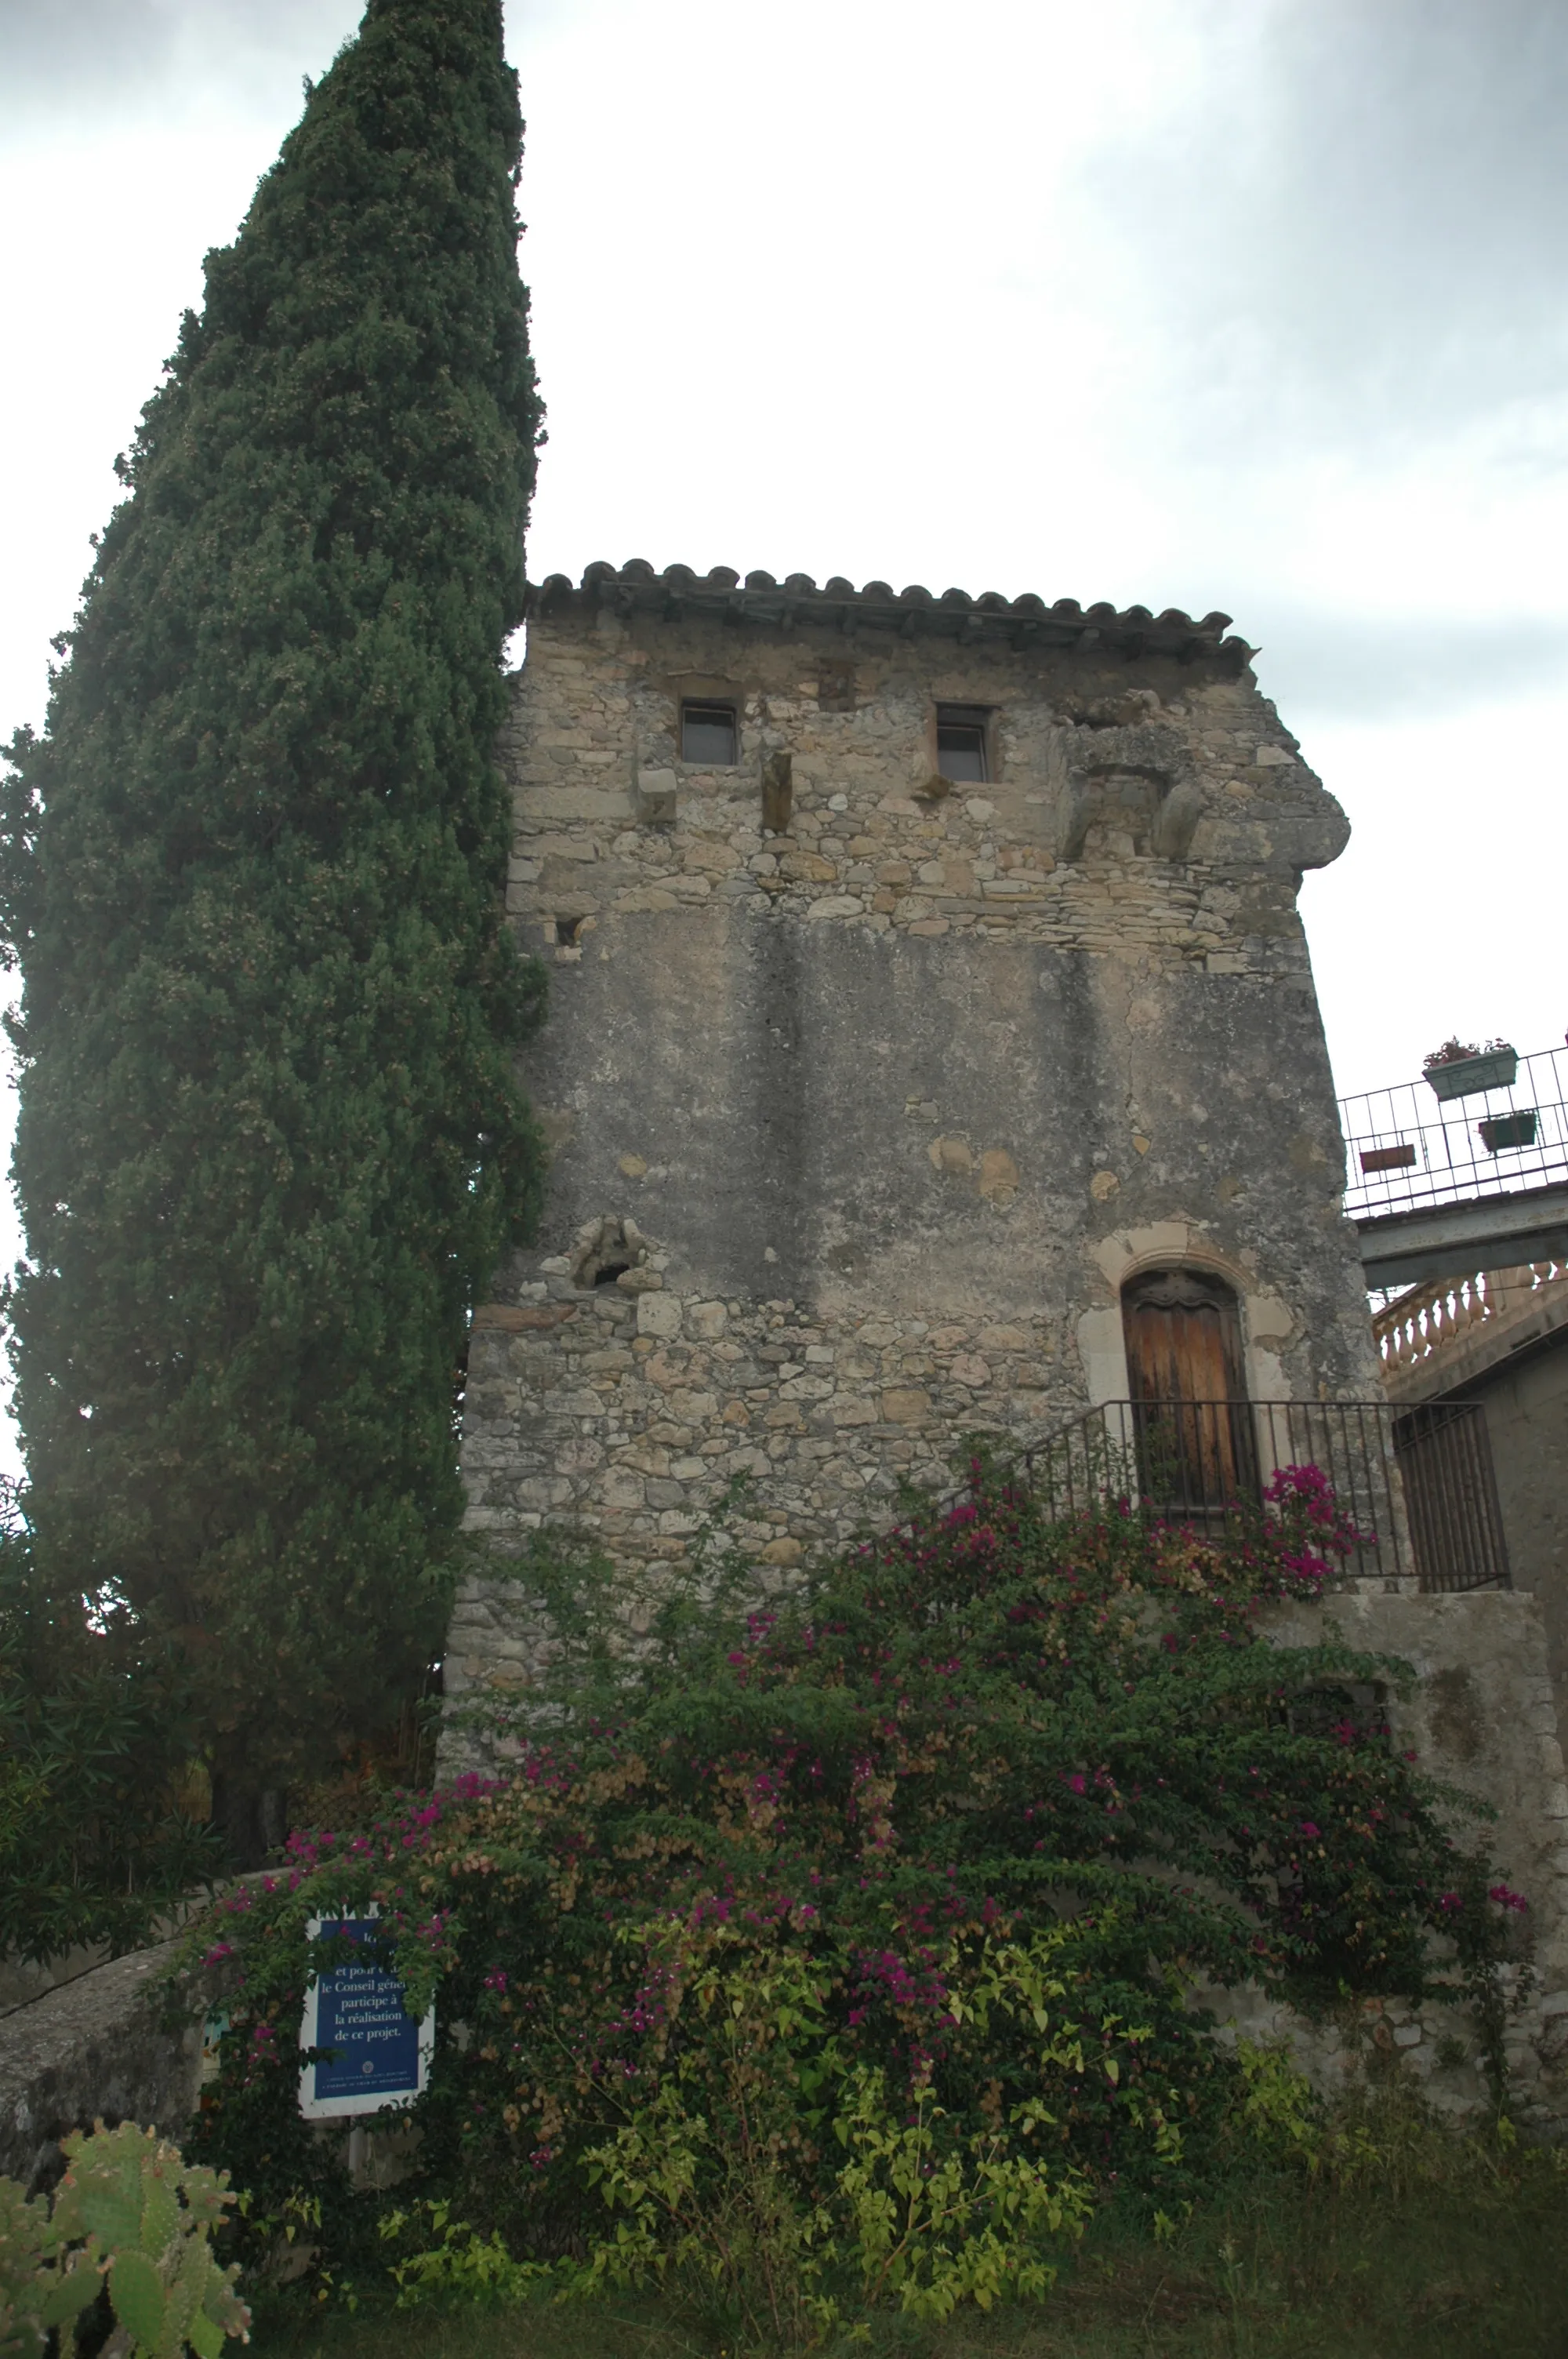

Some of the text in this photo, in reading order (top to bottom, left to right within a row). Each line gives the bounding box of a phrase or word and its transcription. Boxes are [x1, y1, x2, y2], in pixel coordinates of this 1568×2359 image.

[336, 1967, 346, 1976] et
[322, 1983, 332, 1994] le
[335, 1979, 375, 1992] Conseil
[342, 1994, 397, 2012] participe à
[335, 2011, 401, 2025] la réalisation
[335, 2030, 349, 2041] de
[367, 2027, 401, 2042] projet.
